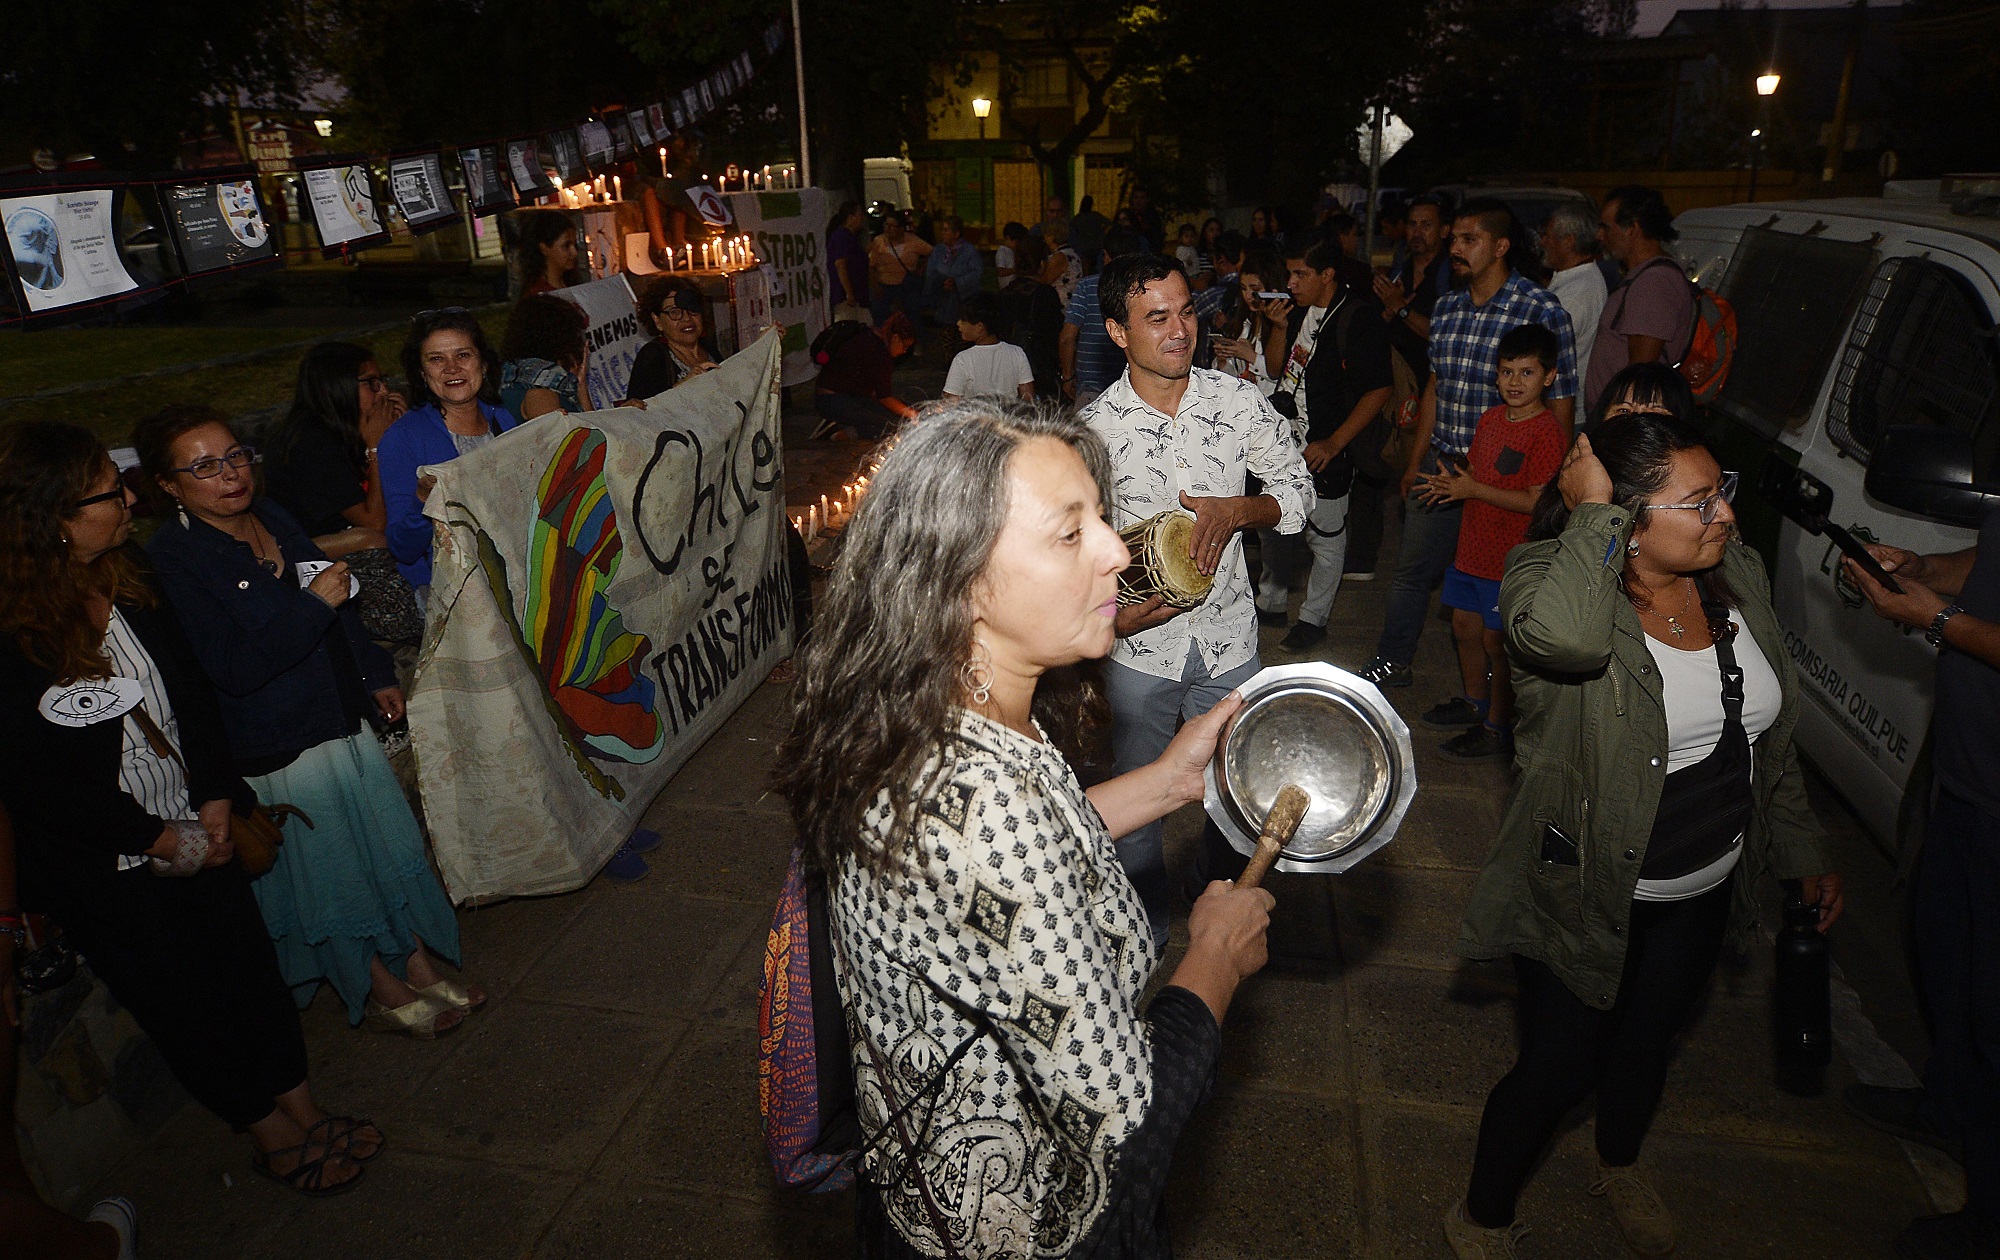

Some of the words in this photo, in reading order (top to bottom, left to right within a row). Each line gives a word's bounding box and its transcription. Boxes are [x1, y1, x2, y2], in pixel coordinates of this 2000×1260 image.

[743, 231, 816, 269] STADO
[585, 313, 638, 353] ENEMOS
[632, 401, 781, 576] Chile
[702, 541, 735, 609] SE
[651, 558, 792, 736] TRANSFORMA
[1784, 631, 1848, 704] COMISARIA
[1848, 691, 1908, 763] QUILPUE
